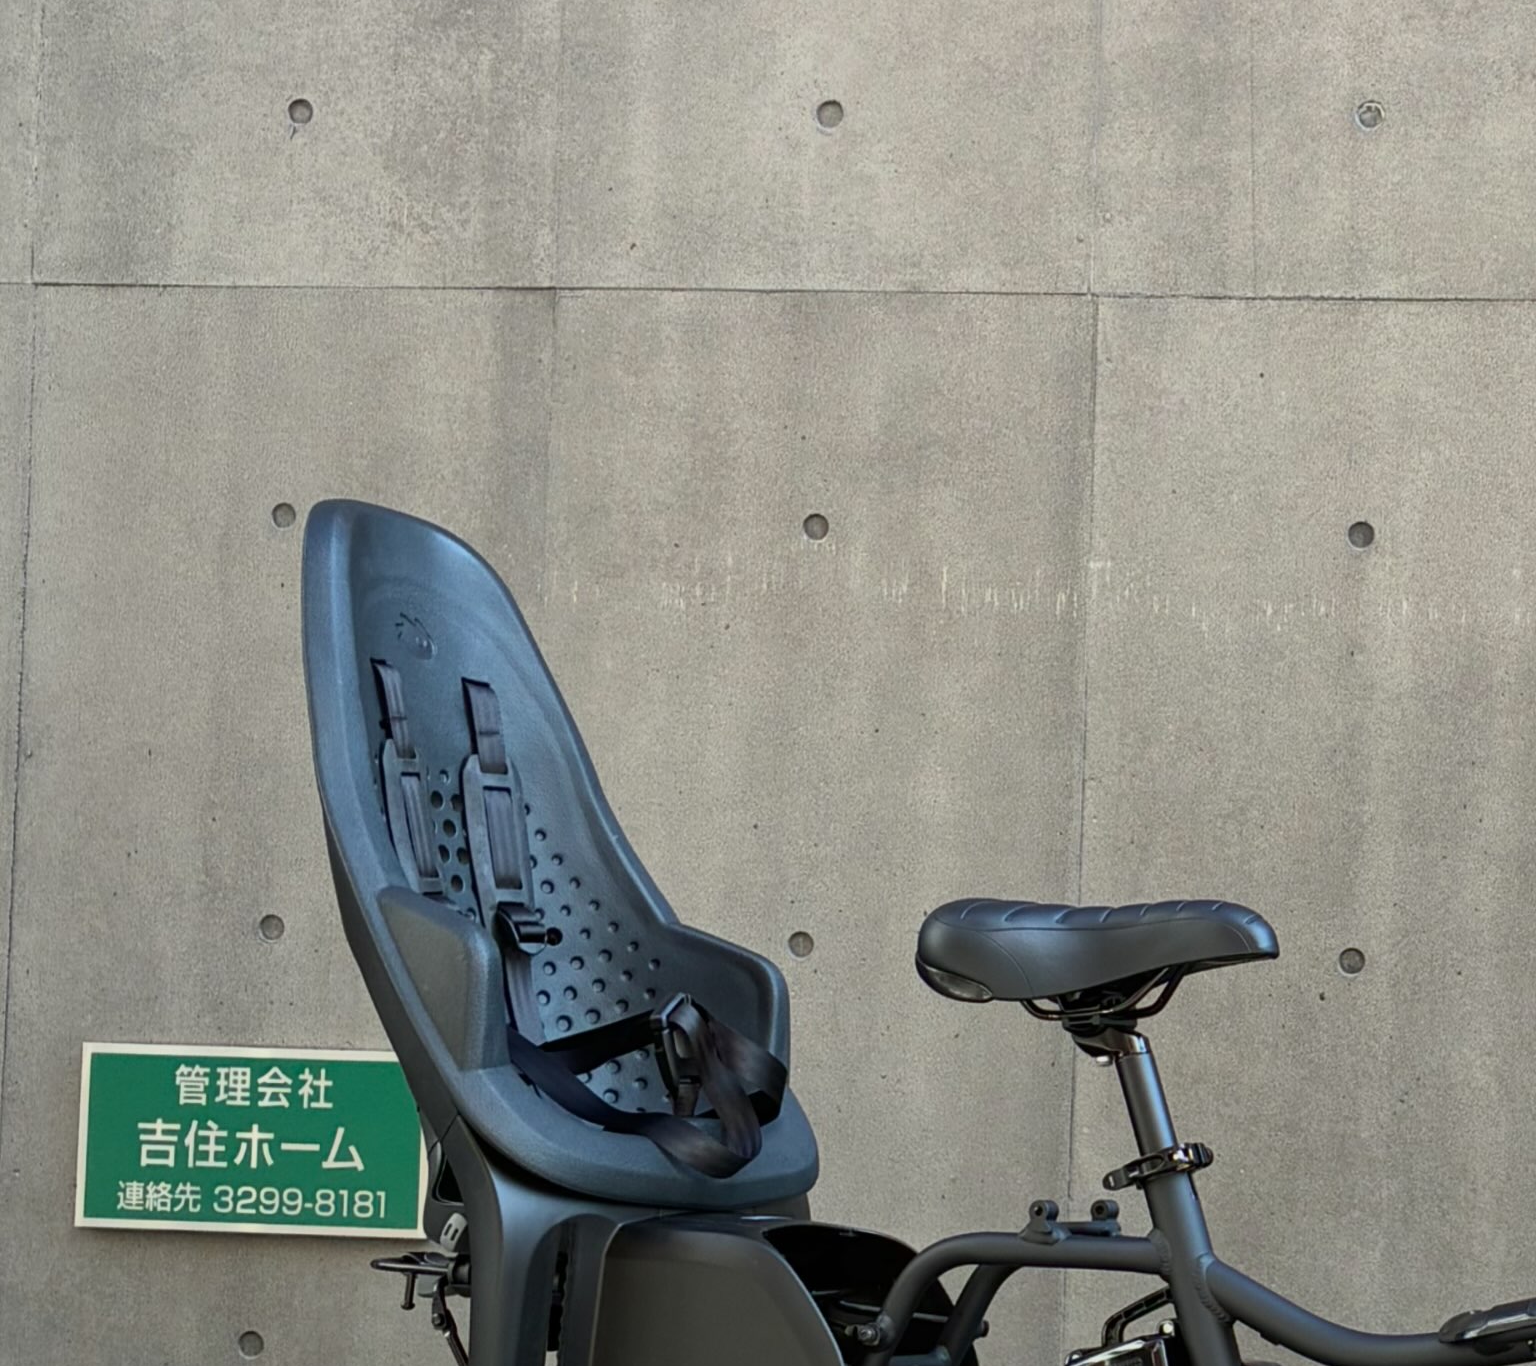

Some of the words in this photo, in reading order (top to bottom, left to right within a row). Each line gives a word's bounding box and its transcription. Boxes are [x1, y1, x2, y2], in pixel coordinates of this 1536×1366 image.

[174, 1064, 334, 1109] 管理会社
[137, 1118, 365, 1172] 吉住ホーム
[117, 1180, 202, 1213] 連絡先
[212, 1185, 387, 1219] 3299-8181
